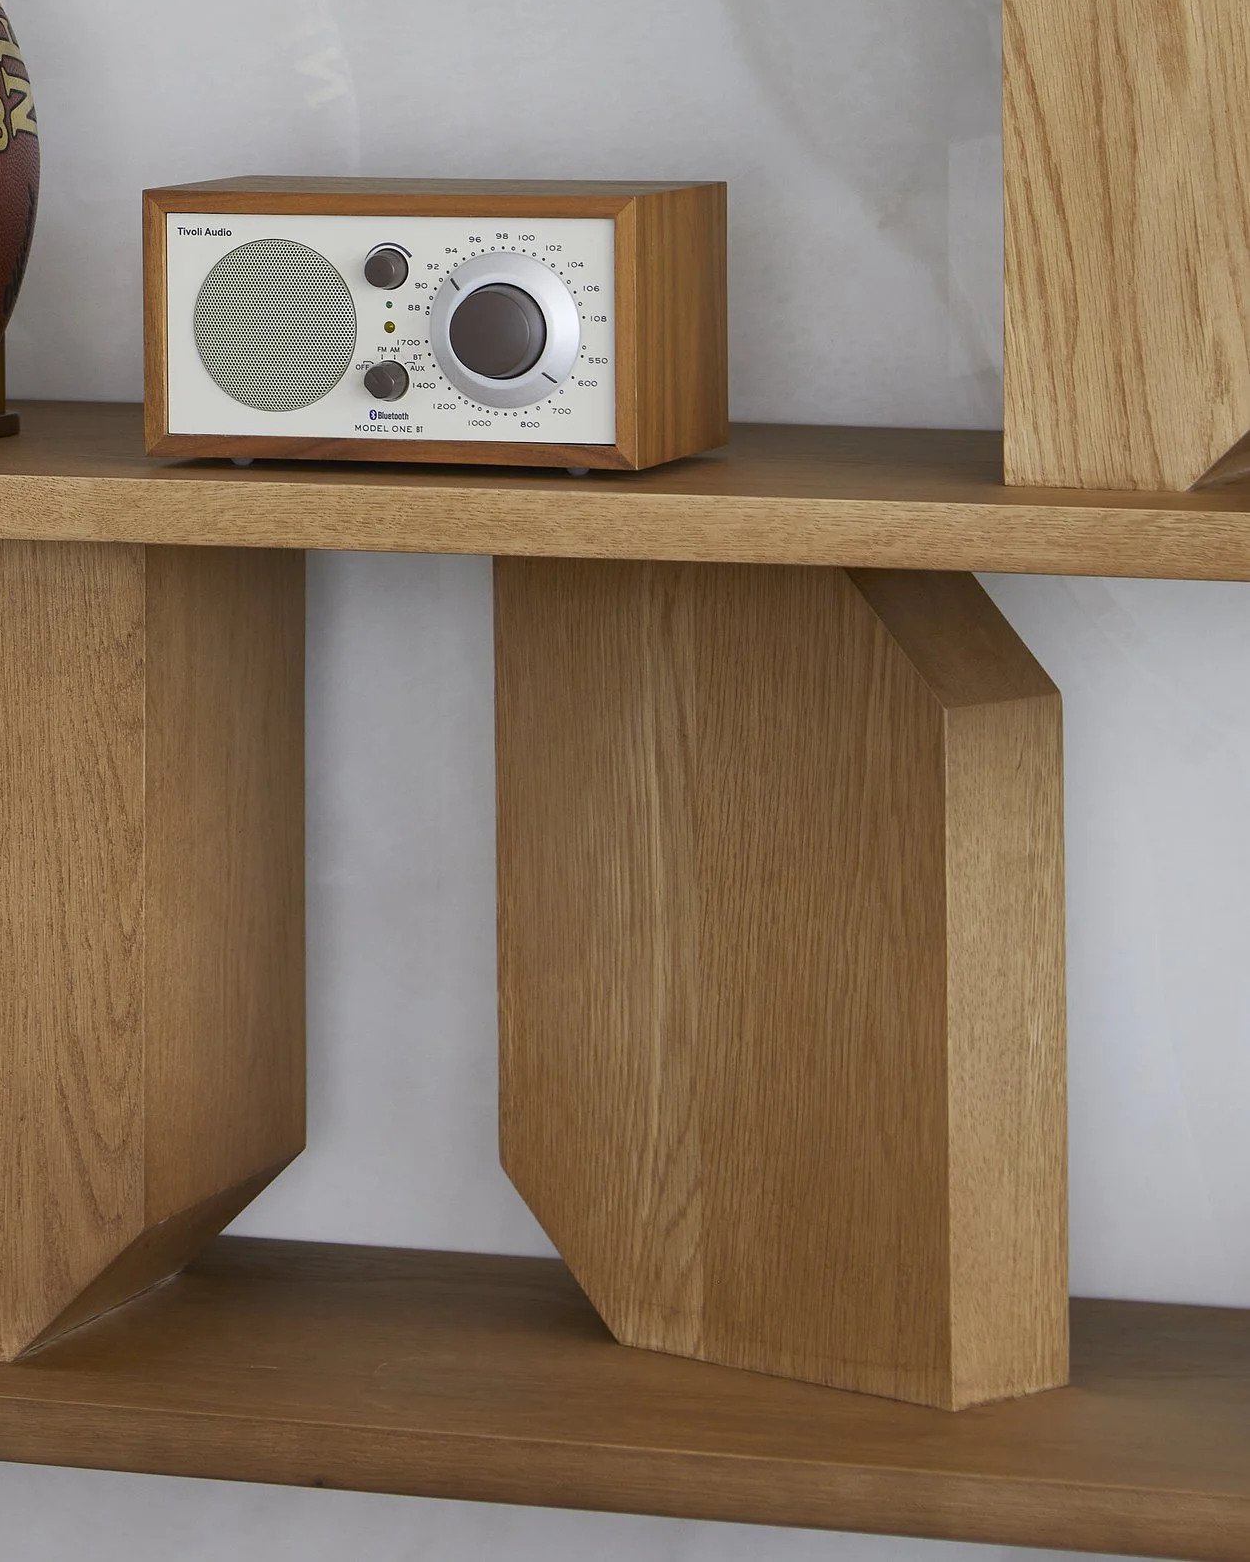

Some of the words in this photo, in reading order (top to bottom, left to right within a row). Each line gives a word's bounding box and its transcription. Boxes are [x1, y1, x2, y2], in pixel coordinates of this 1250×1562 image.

[177, 227, 203, 236] Tivoli
[204, 227, 232, 236] Audio
[377, 412, 409, 420] Bluetooth
